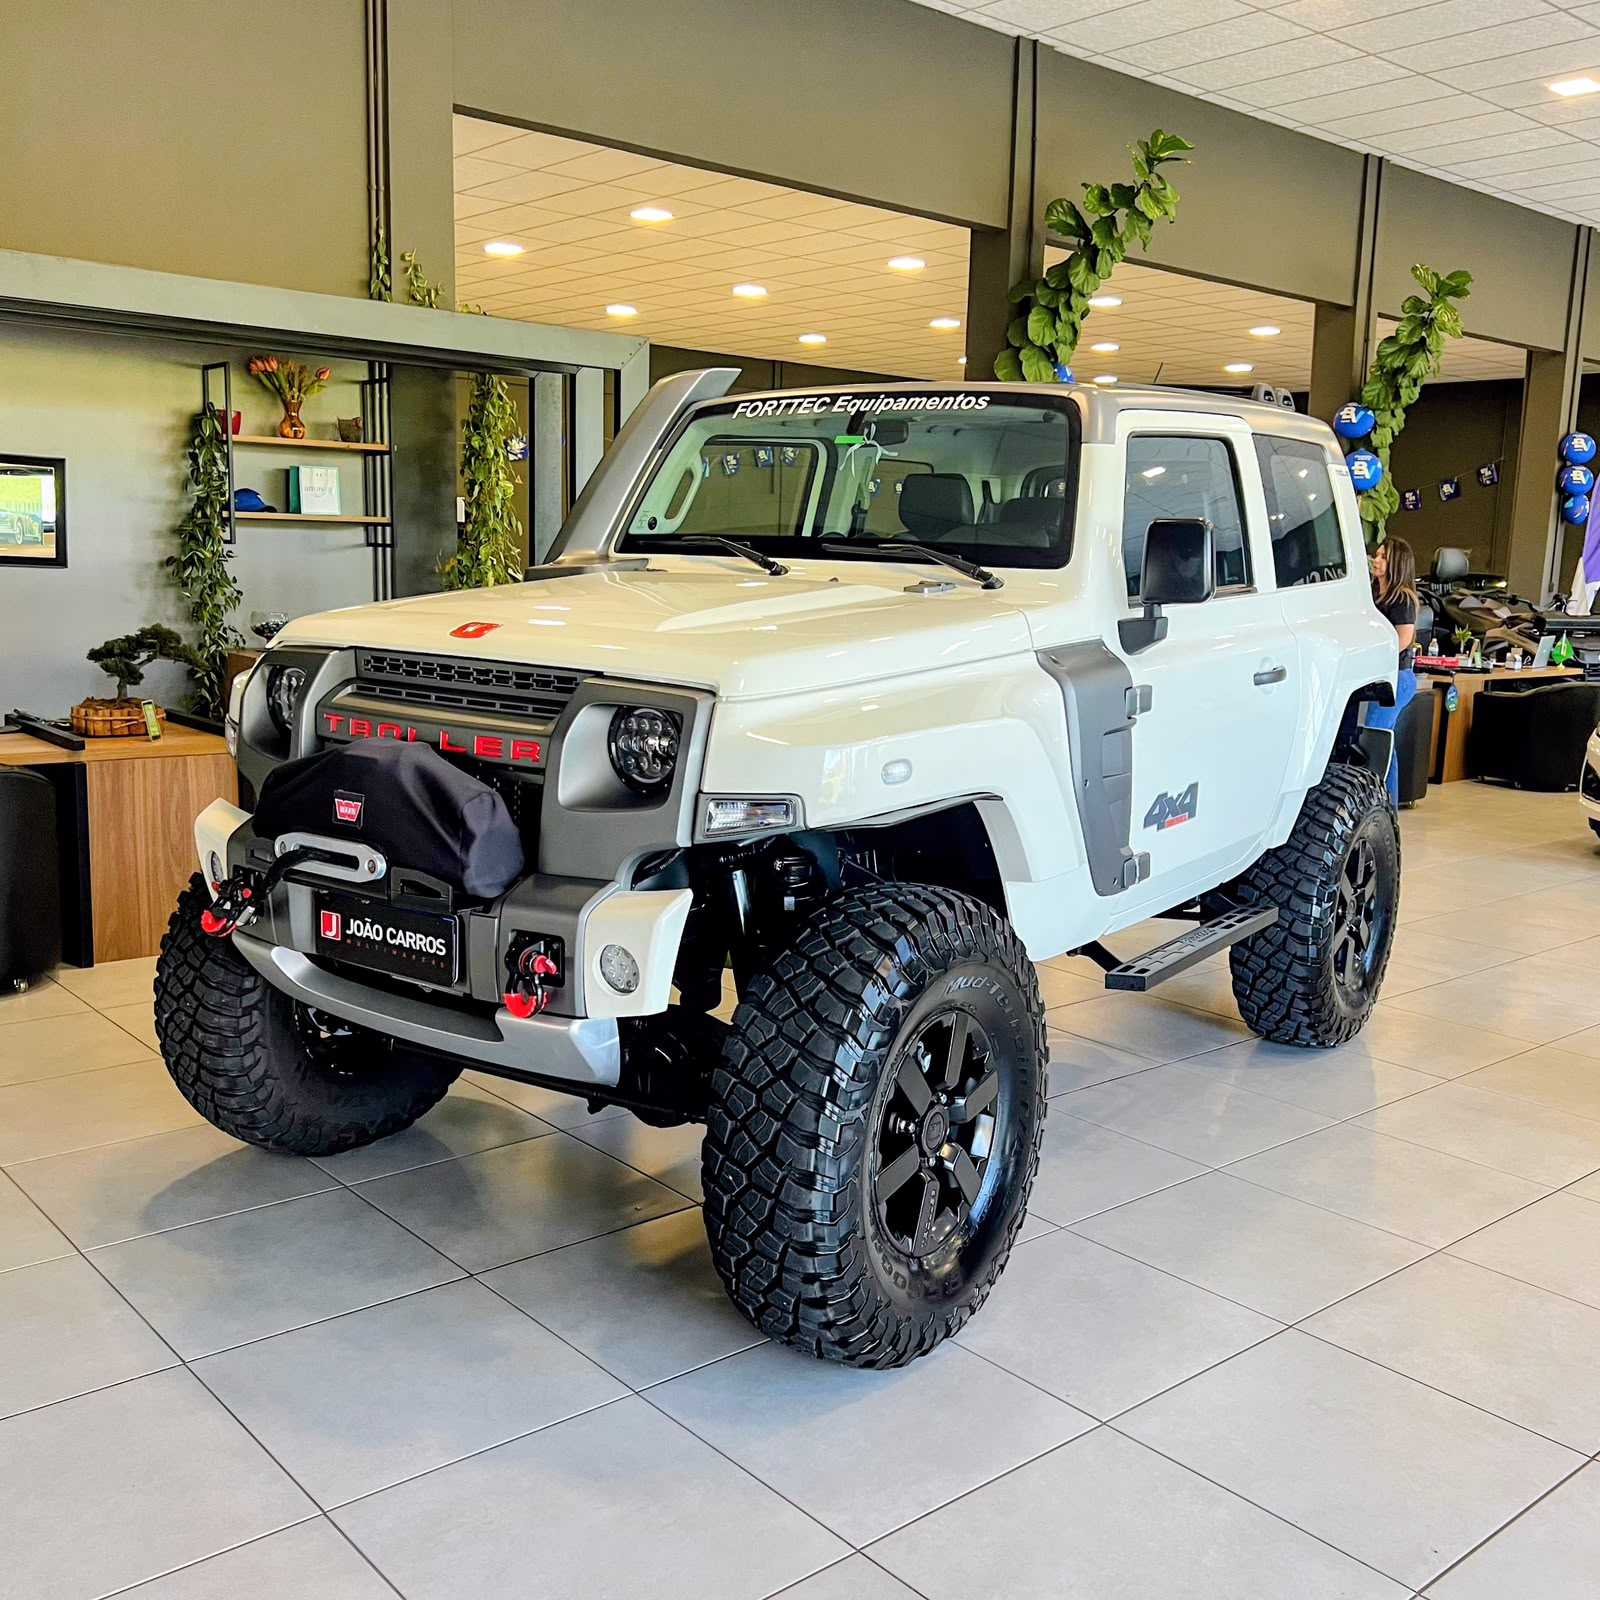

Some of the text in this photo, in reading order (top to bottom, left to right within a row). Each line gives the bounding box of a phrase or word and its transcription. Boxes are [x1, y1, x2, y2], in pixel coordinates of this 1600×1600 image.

[732, 393, 990, 419] FORTTEC Equipamentos
[346, 917, 446, 956] JOÃO CARROS
